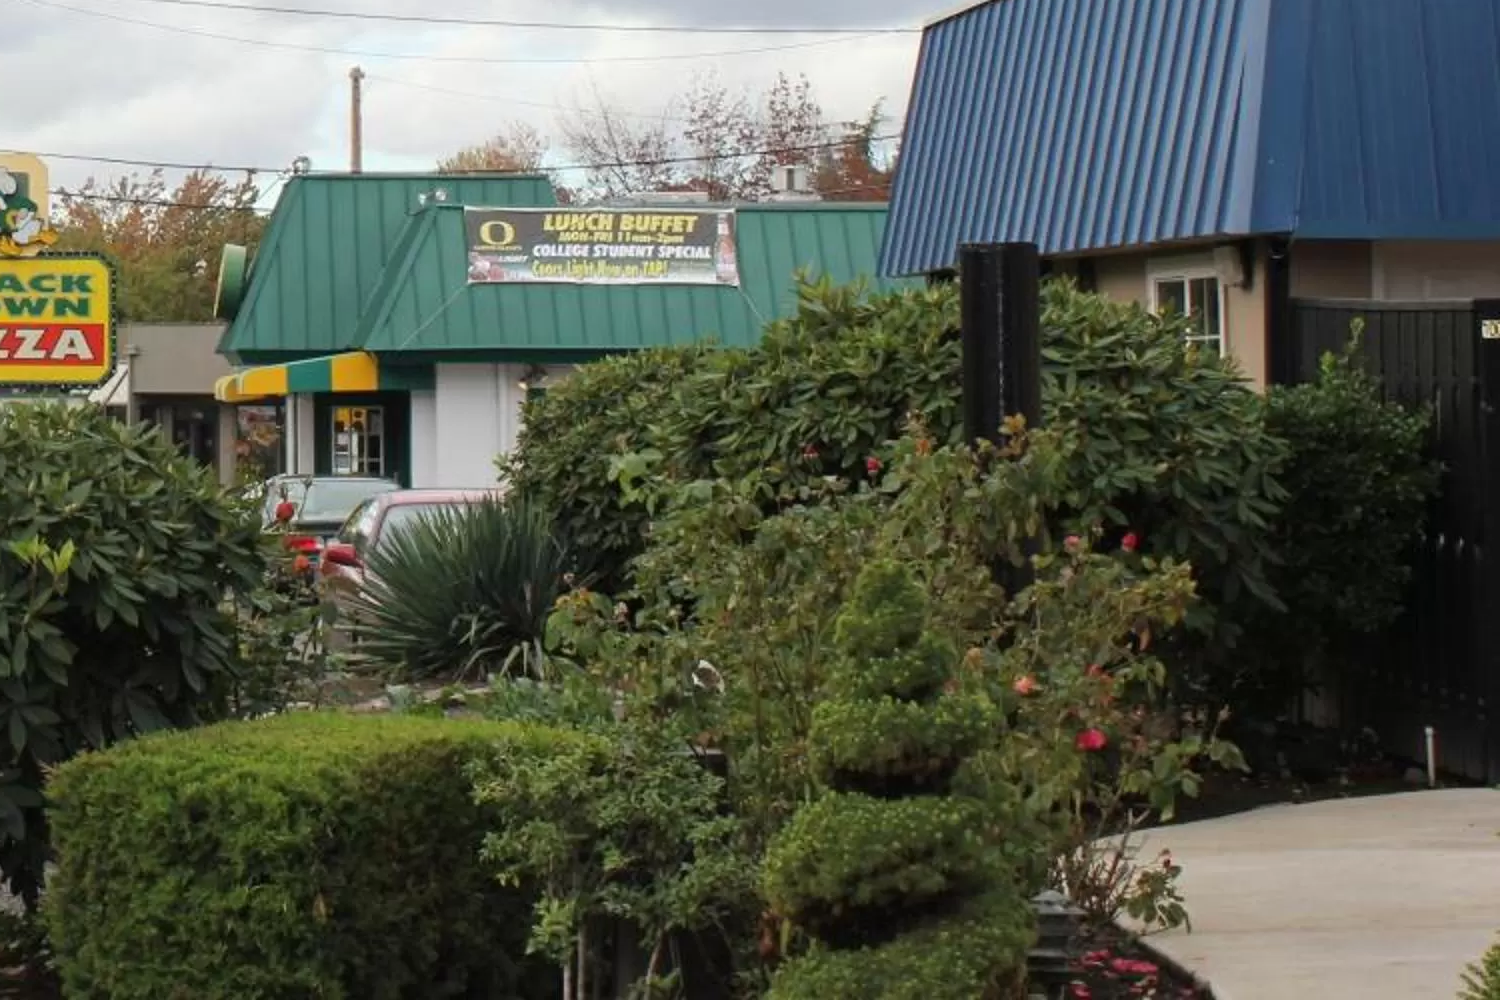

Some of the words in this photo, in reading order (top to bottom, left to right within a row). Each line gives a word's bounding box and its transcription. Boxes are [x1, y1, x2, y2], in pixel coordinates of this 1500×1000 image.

[543, 213, 613, 231] LUNCH
[619, 215, 699, 233] BUFFET
[533, 244, 590, 257] COLLEGE
[592, 244, 655, 258] STUDENT
[658, 245, 712, 259] SPECIAL
[532, 260, 563, 278] Coors
[567, 260, 594, 280] Light
